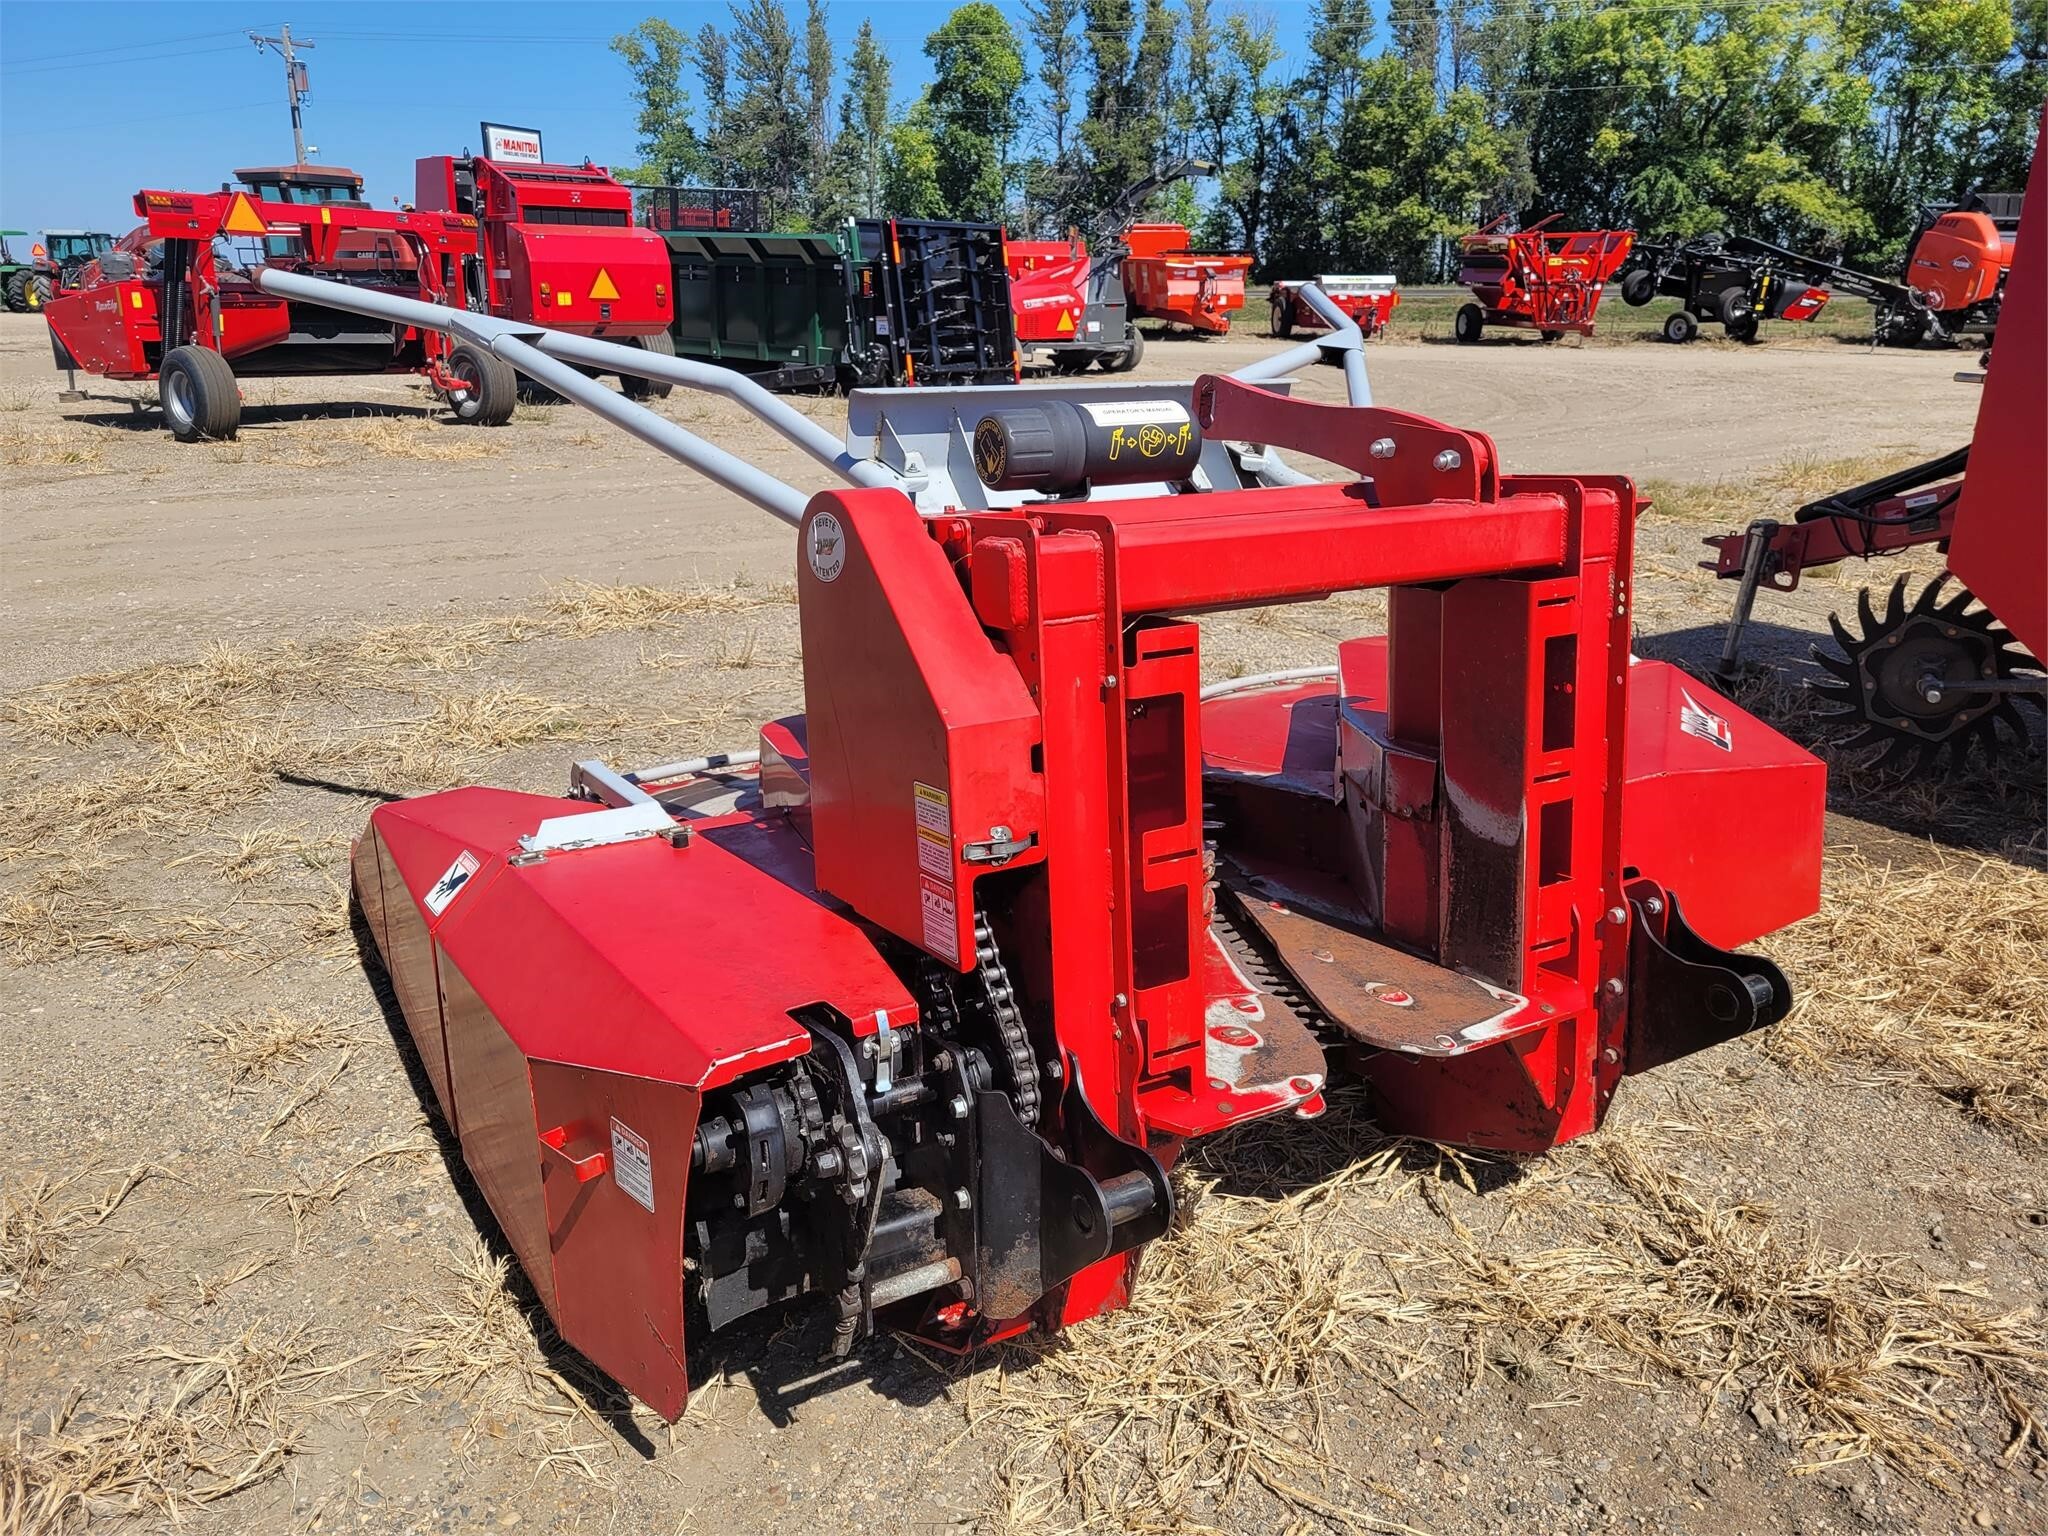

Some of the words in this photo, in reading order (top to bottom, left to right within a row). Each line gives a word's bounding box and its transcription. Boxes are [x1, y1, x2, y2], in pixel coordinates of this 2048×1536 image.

[503, 138, 538, 153] MANITOU
[976, 421, 1003, 442] OPERATOR'S
[924, 788, 943, 802] WARNING
[929, 879, 951, 899] DANGER
[621, 1128, 644, 1151] DANGER
